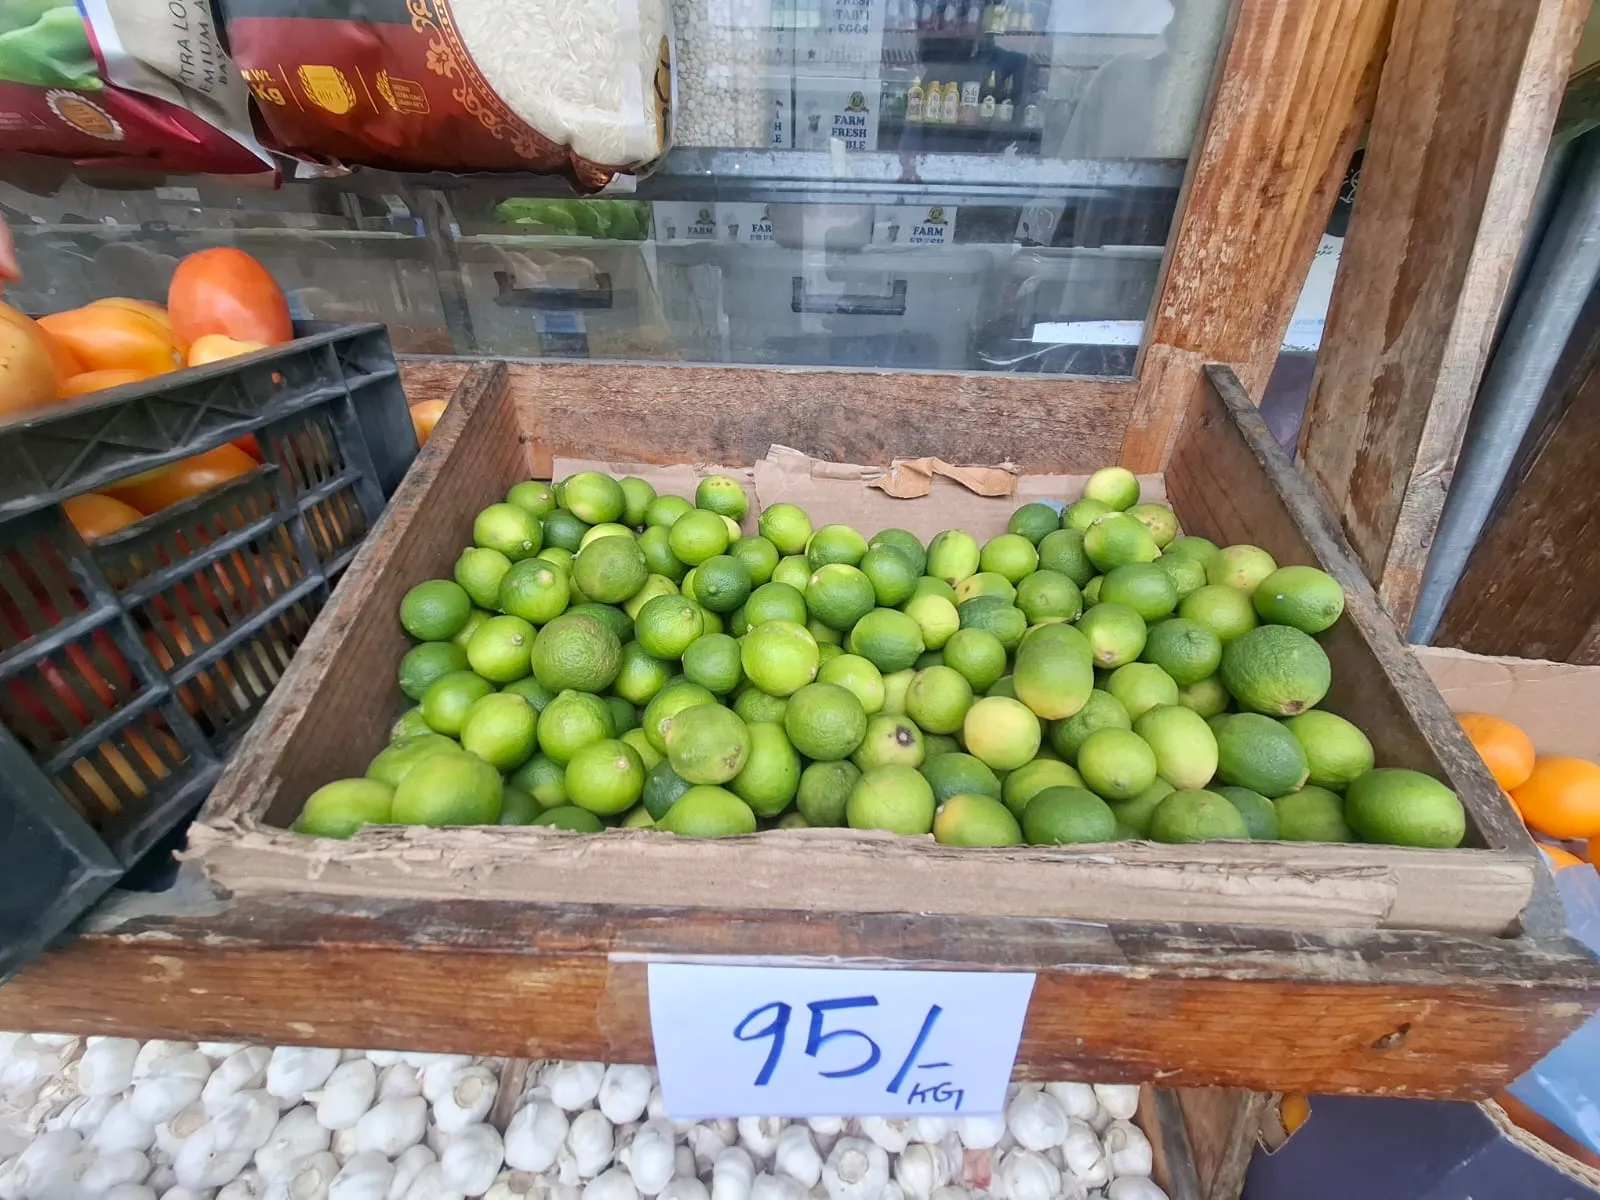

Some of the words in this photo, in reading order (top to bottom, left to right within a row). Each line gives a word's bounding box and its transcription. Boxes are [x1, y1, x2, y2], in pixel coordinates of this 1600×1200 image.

[838, 23, 869, 34] EGGS
[833, 114, 866, 126] FARM
[831, 127, 867, 138] FRESH
[751, 223, 773, 233] FAR
[912, 226, 944, 237] FARM
